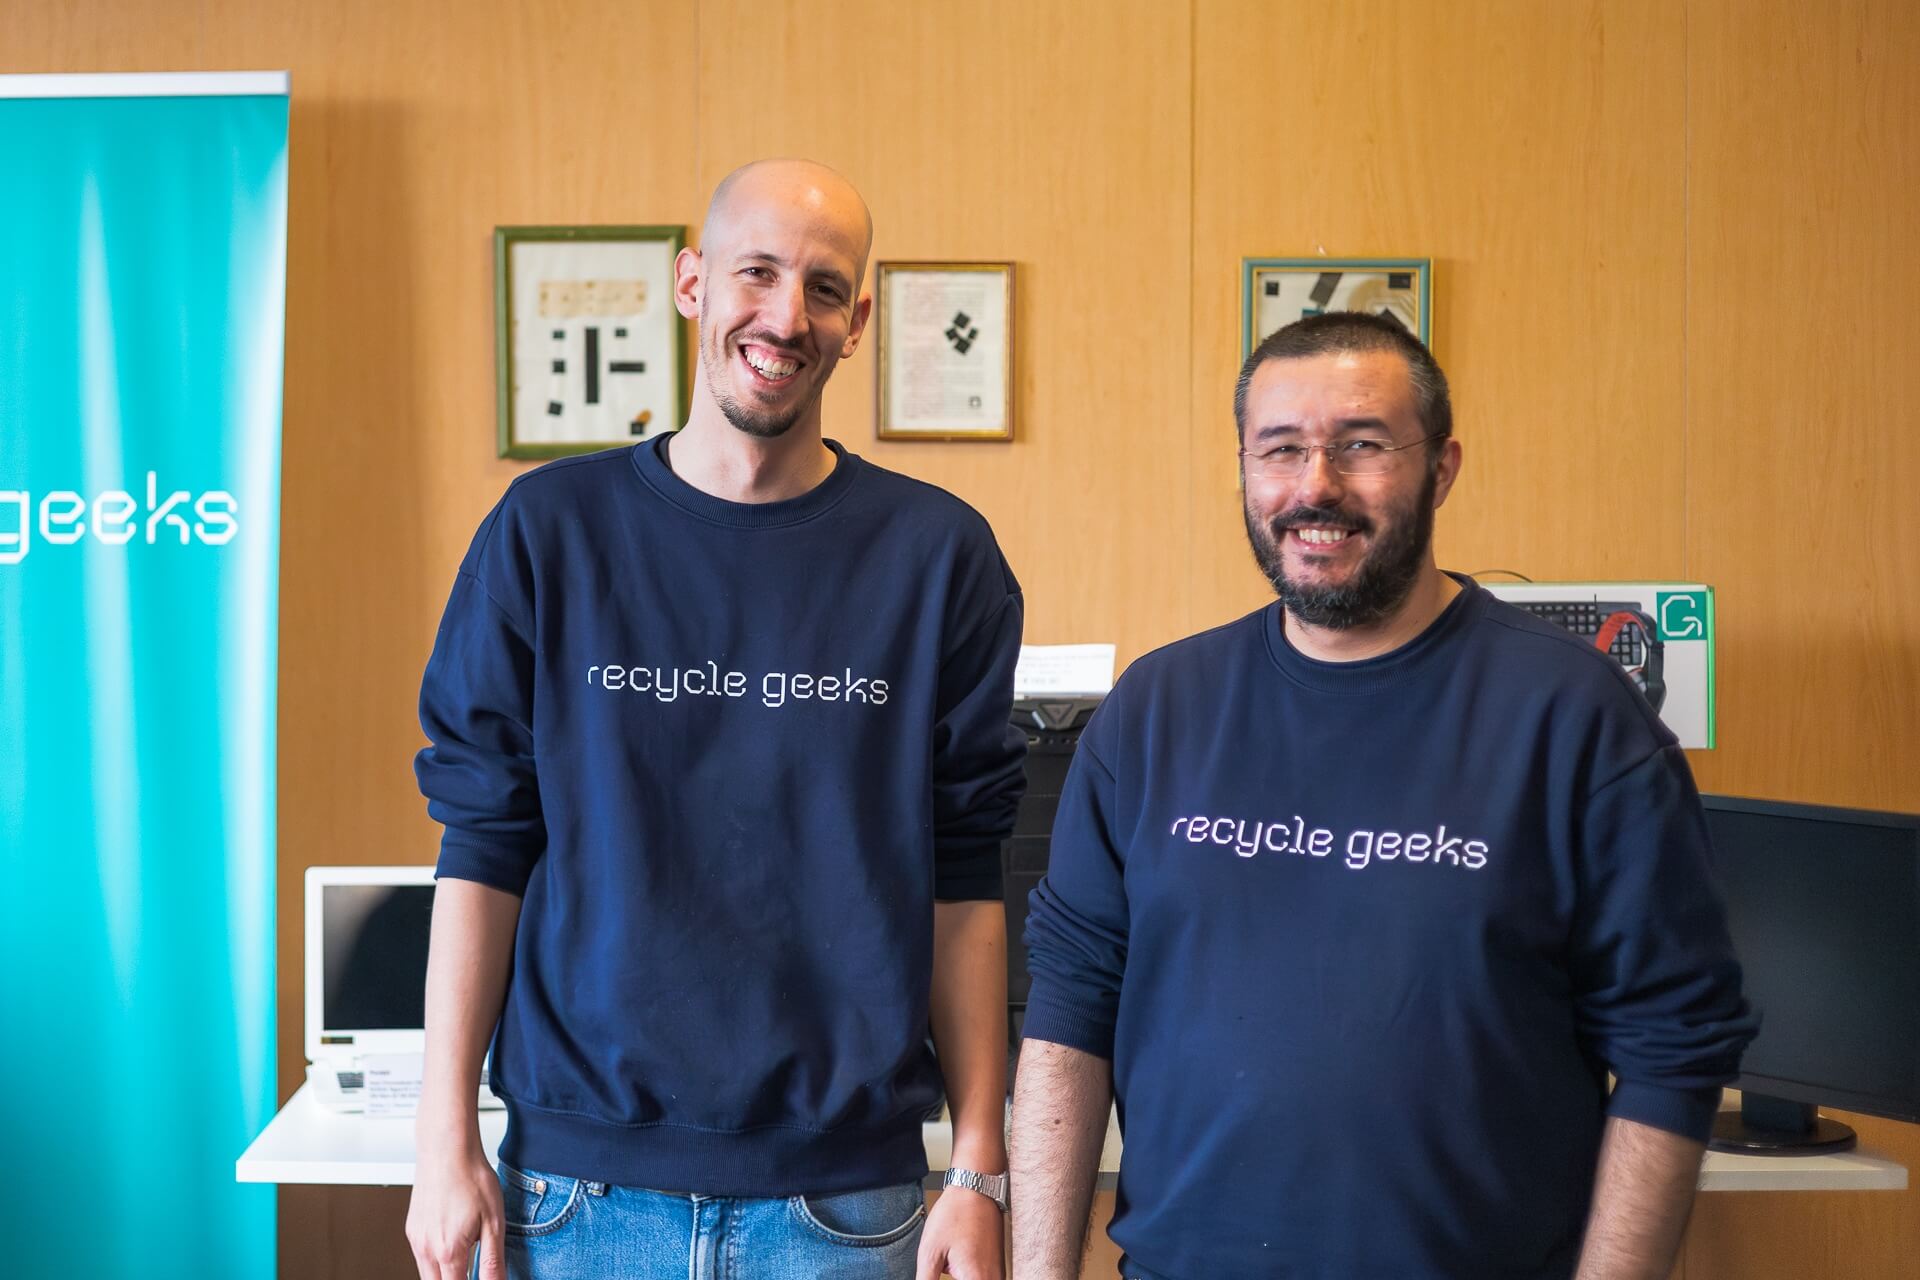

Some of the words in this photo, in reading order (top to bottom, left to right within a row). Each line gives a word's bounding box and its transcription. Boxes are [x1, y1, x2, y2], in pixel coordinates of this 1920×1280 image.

[587, 660, 747, 703] recycle
[762, 667, 889, 708] geeks
[1171, 815, 1334, 858] recycle
[1345, 825, 1489, 870] geeks
